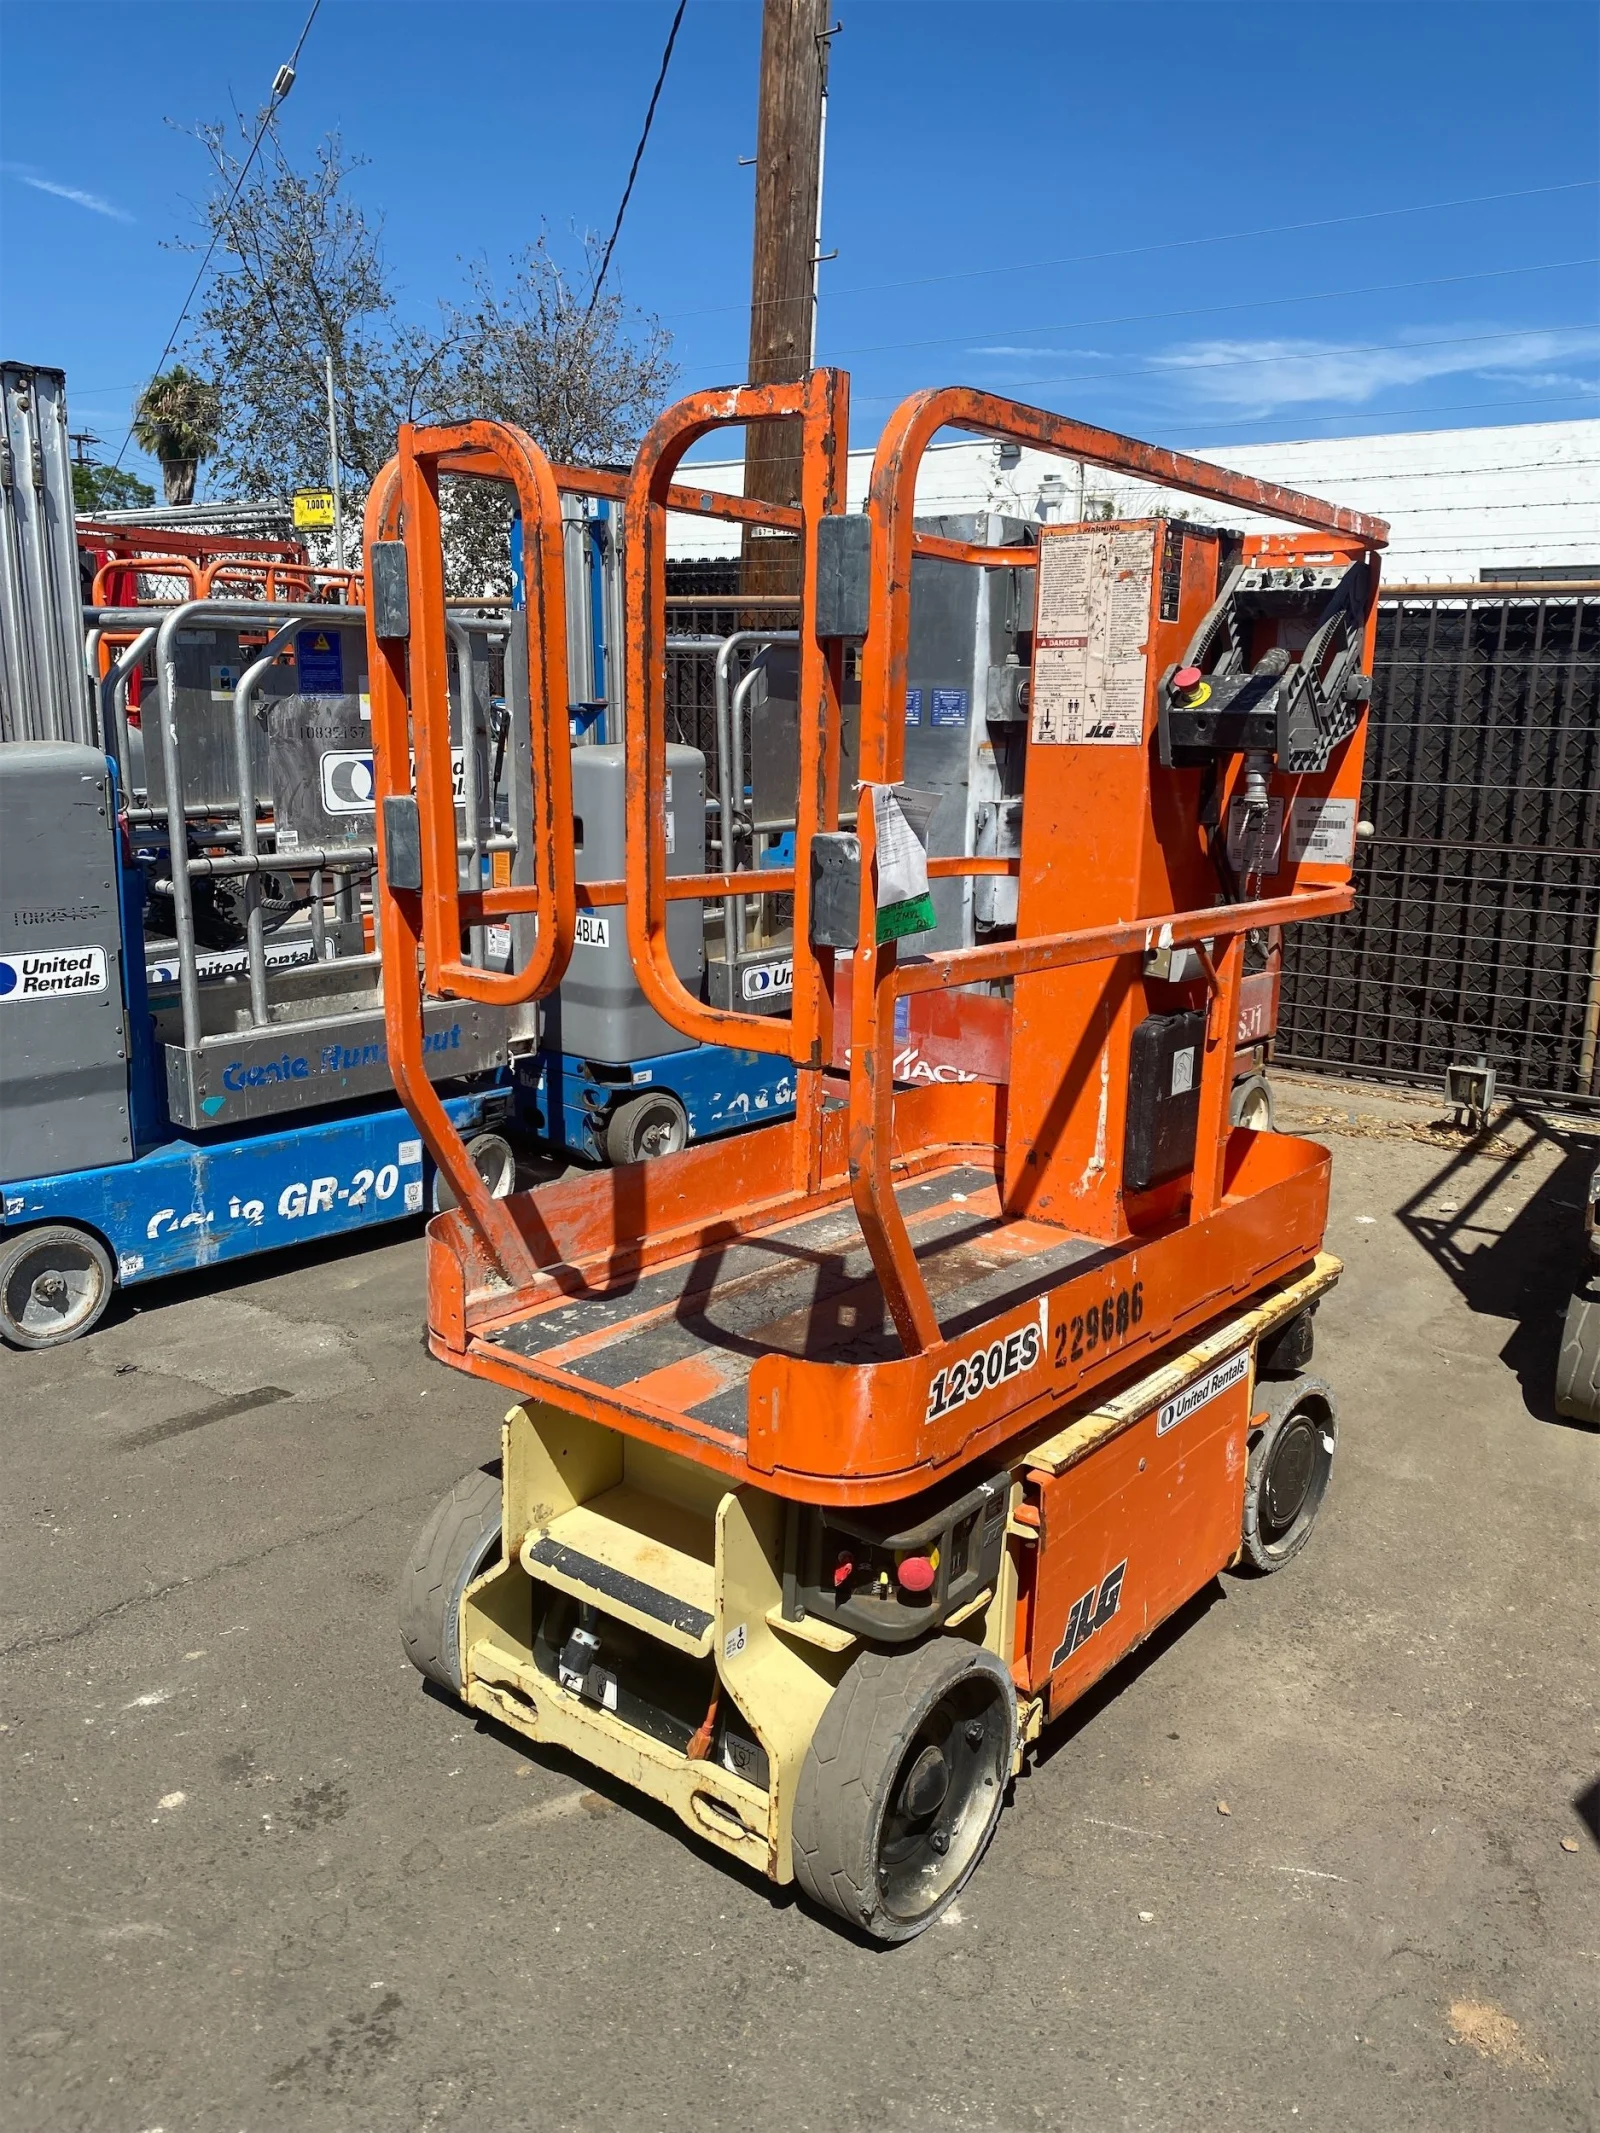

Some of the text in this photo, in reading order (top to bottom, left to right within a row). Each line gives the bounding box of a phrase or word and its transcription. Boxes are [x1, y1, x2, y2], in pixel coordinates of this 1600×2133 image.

[306, 499, 325, 511] 7,000
[1085, 724, 1116, 738] JLG
[574, 918, 606, 945] 4BLA
[22, 953, 93, 976] United
[23, 971, 101, 993] Rentals
[179, 947, 319, 978] nited ental
[223, 1023, 463, 1092] Genie Runut
[277, 1164, 399, 1220] GR-20
[1054, 1281, 1144, 1369] 229686
[927, 1325, 1041, 1420] 1230ES
[1176, 1382, 1210, 1418] United
[1210, 1358, 1246, 1393] Rentals
[1049, 1557, 1128, 1672] JLG
